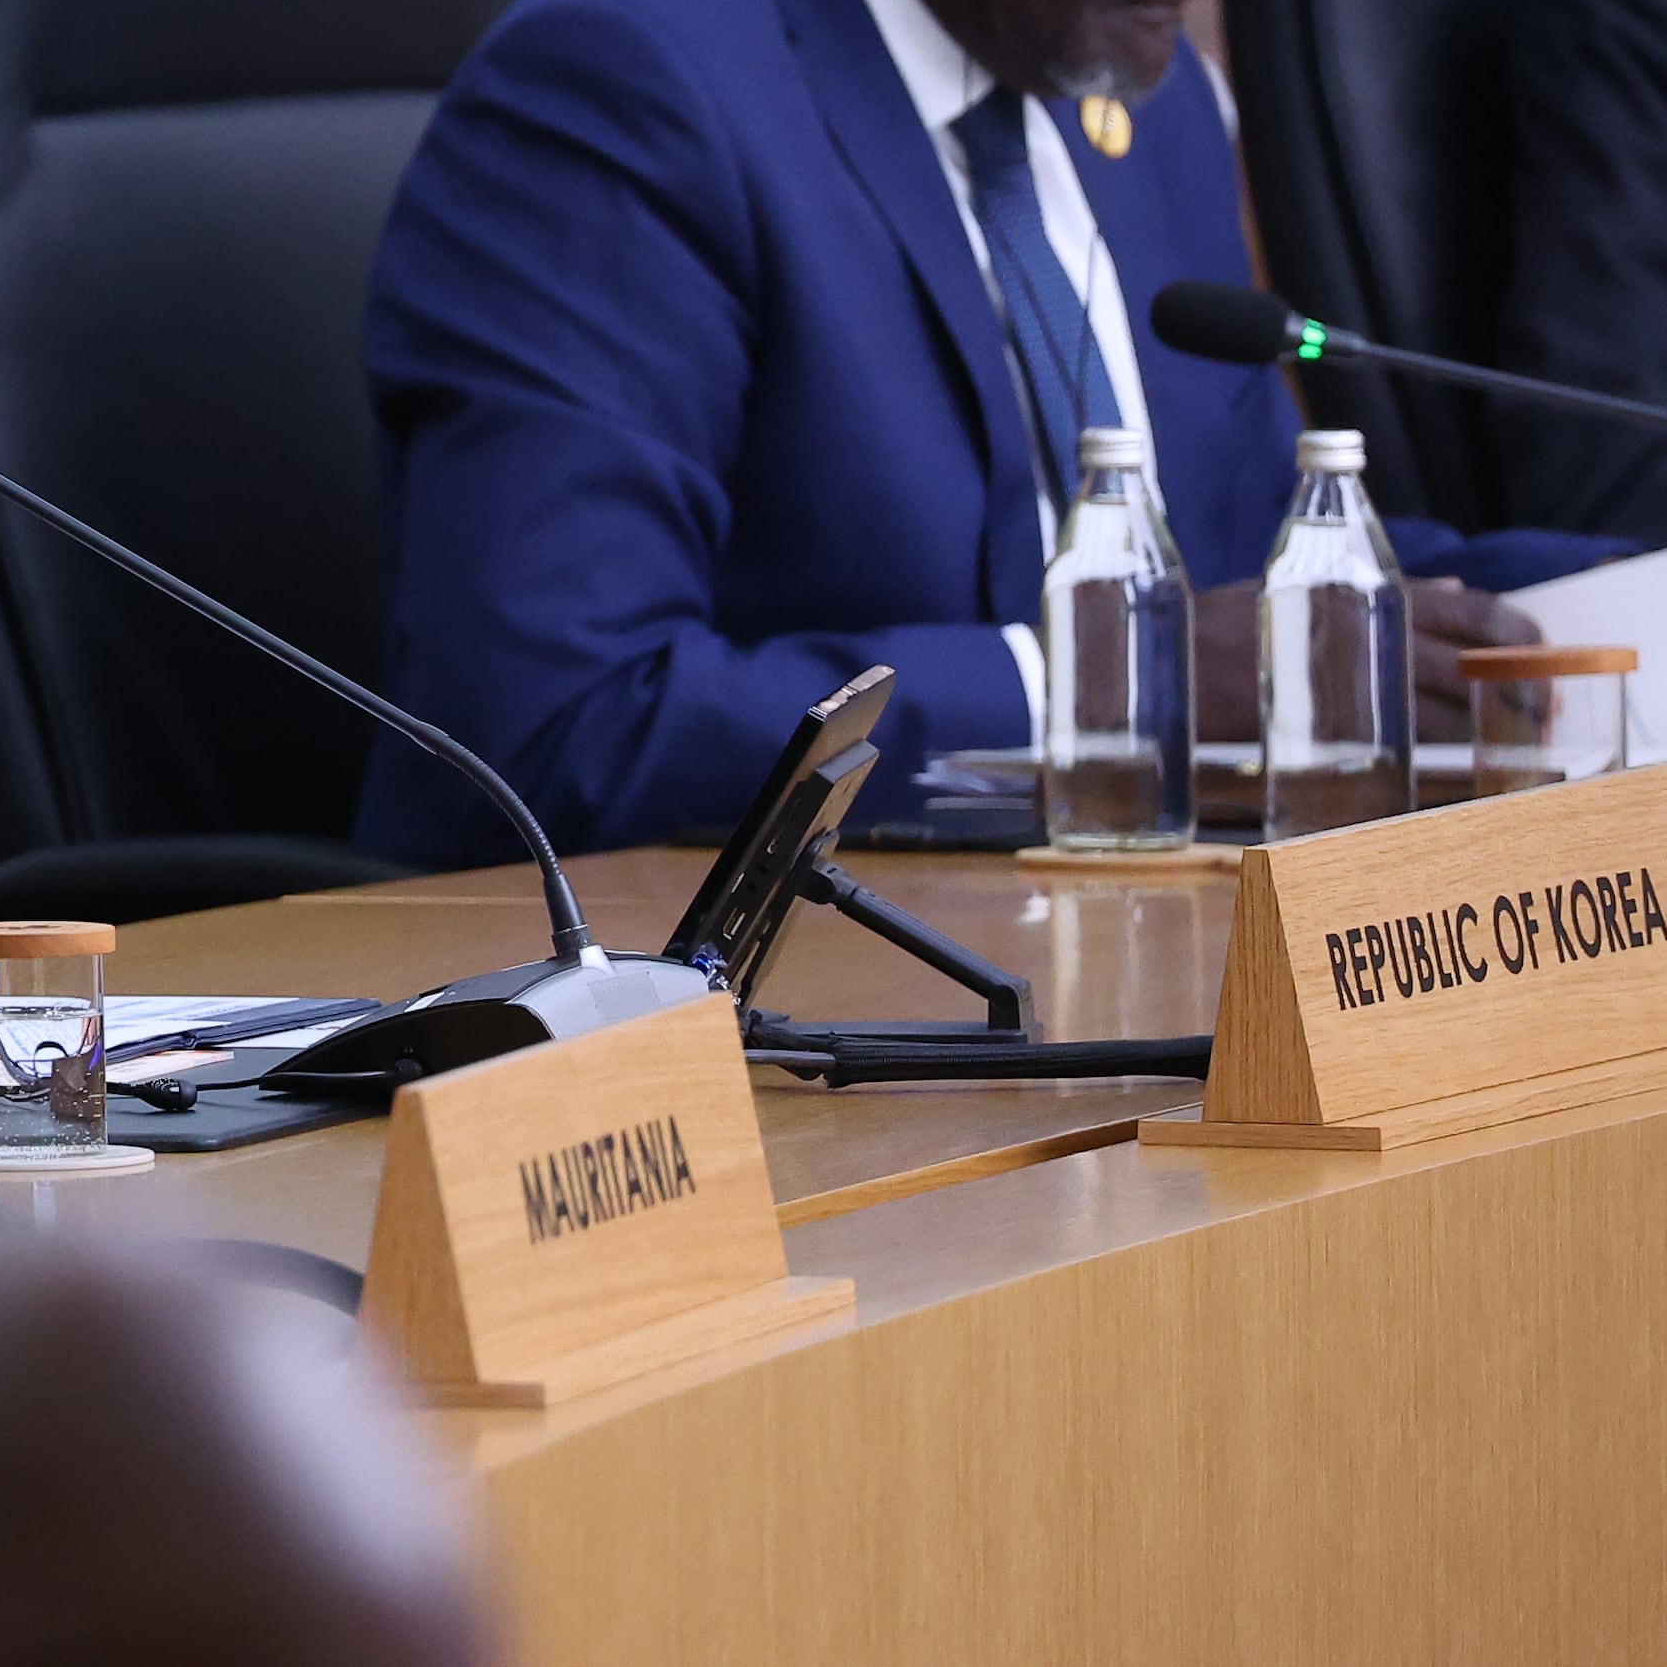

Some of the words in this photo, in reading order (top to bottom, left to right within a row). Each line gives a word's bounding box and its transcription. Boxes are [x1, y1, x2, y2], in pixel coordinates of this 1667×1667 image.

[1325, 903, 1488, 1011] REPUBLIC
[1493, 891, 1540, 975] OF
[1545, 867, 1667, 965] KOREA
[520, 1114, 696, 1245] MAURITANIA
